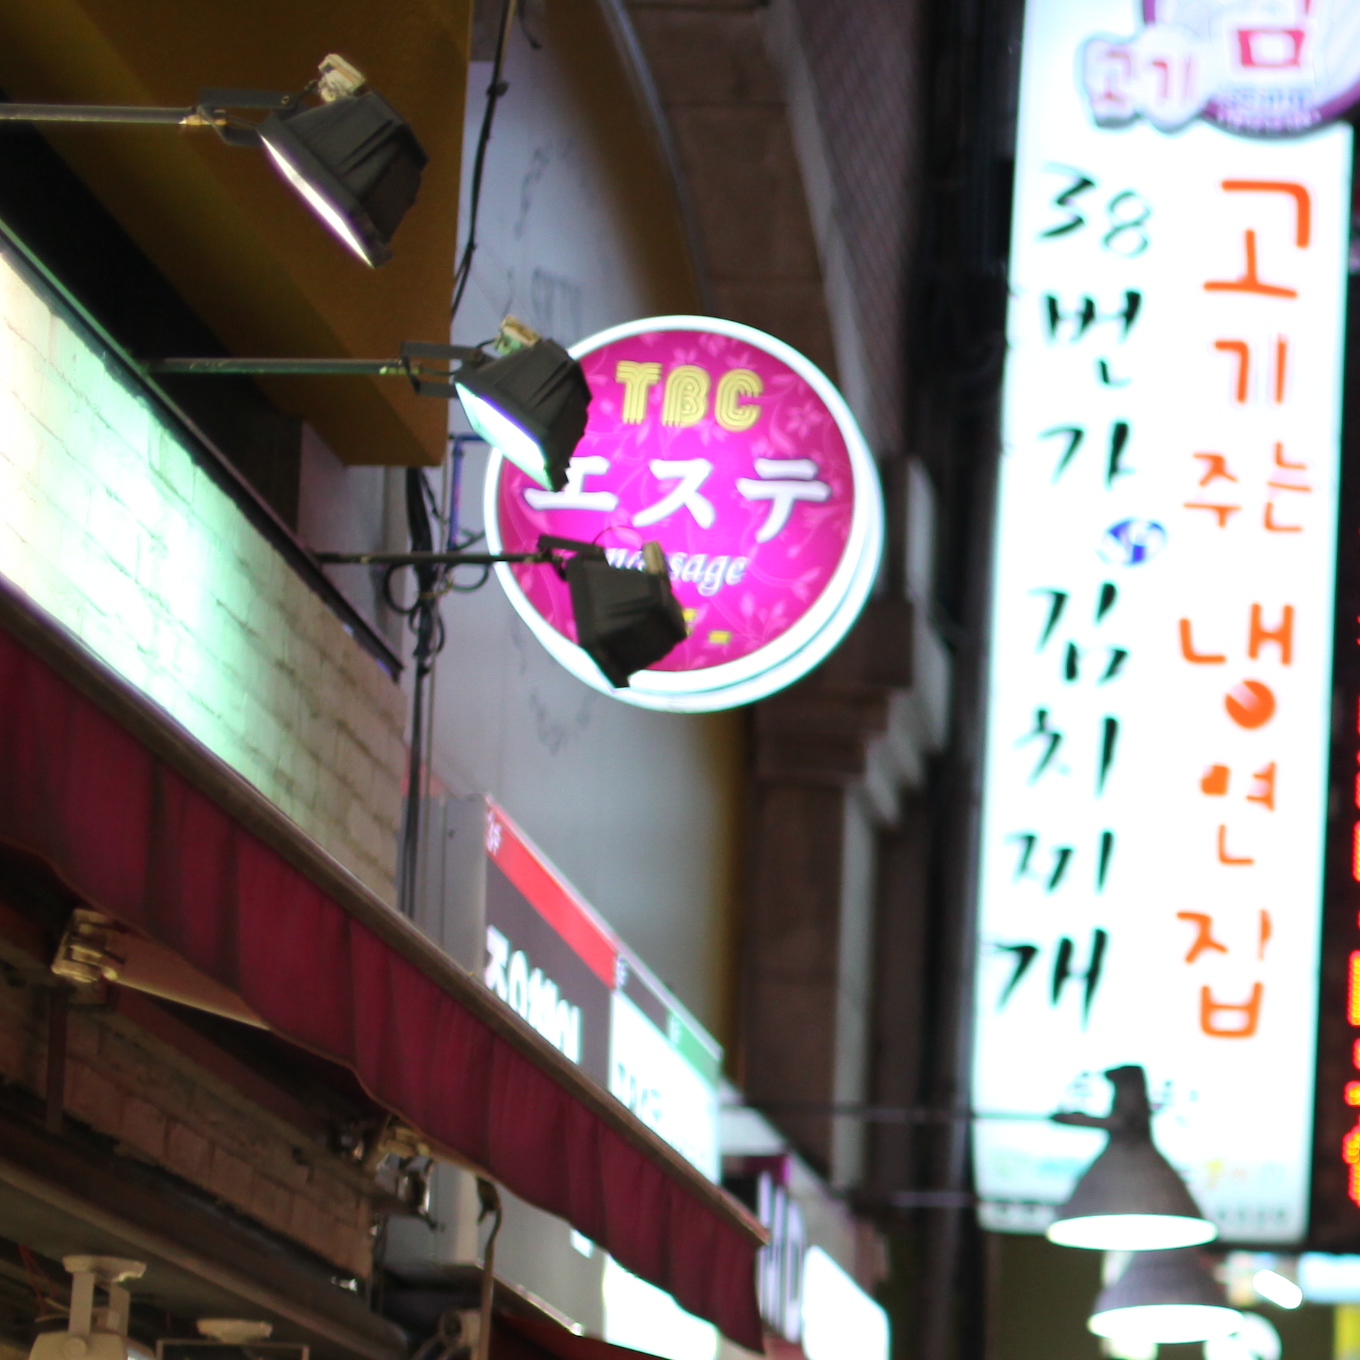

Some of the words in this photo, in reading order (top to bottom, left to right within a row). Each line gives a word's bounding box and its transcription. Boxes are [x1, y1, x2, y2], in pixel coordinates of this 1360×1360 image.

[1201, 178, 1311, 406] 고기
[615, 360, 763, 433] TBC
[523, 454, 833, 545] エステ
[1175, 600, 1296, 1040] 냉면집
